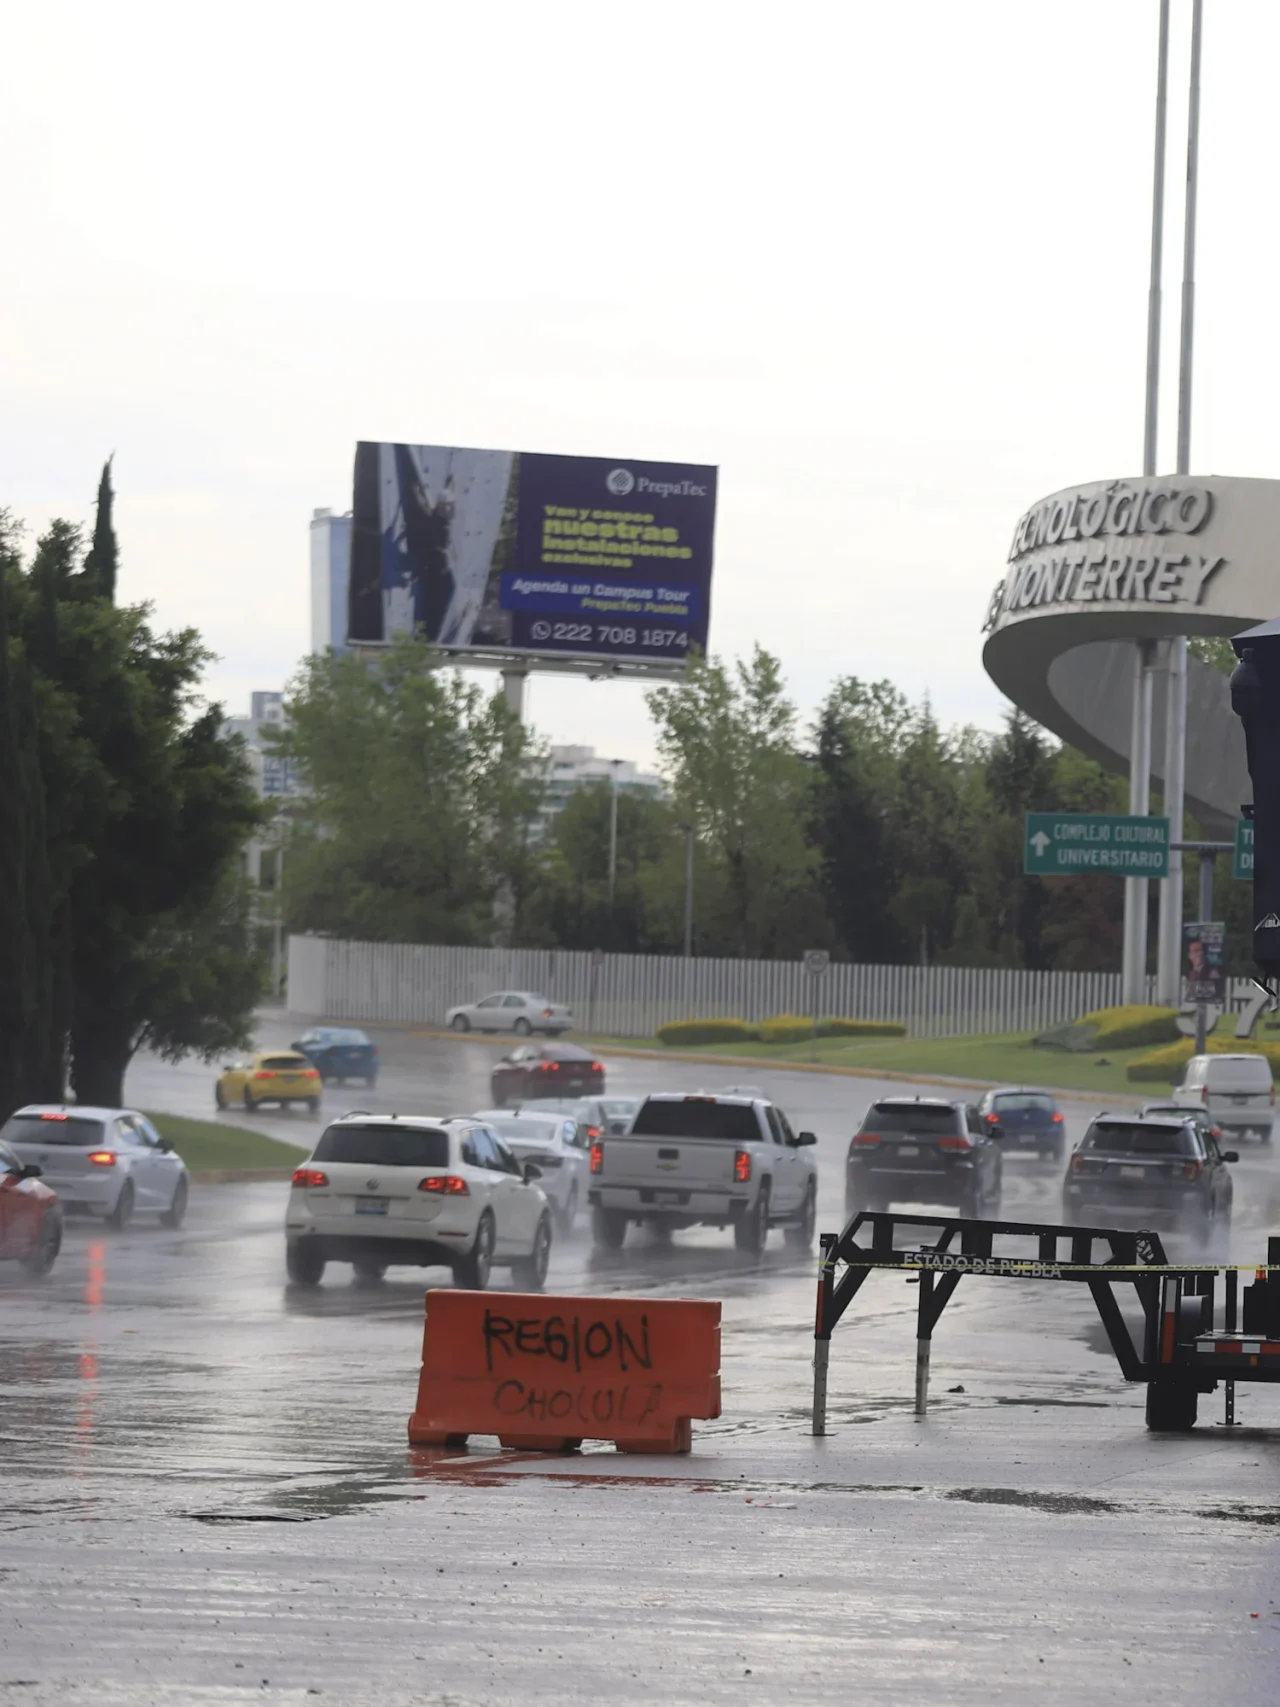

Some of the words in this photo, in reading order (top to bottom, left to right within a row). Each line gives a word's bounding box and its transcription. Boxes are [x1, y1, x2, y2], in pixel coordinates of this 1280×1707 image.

[637, 477, 707, 498] PrepaTec
[543, 519, 679, 542] nuestras
[542, 534, 692, 559] instalaciones
[512, 578, 569, 595] Agenda
[572, 584, 591, 595] un
[593, 584, 653, 600] Campus
[656, 587, 690, 602] Tour
[1006, 552, 1229, 610] MONTERREY
[552, 623, 592, 641] 222
[598, 626, 636, 644] 708
[641, 629, 688, 647] 1874
[1054, 824, 1111, 842] COMPLEJO
[1114, 826, 1166, 844] CULTURAL
[1057, 849, 1163, 868] UNIVERSITARIO
[973, 1258, 996, 1274] DE
[482, 1309, 654, 1373] REGION
